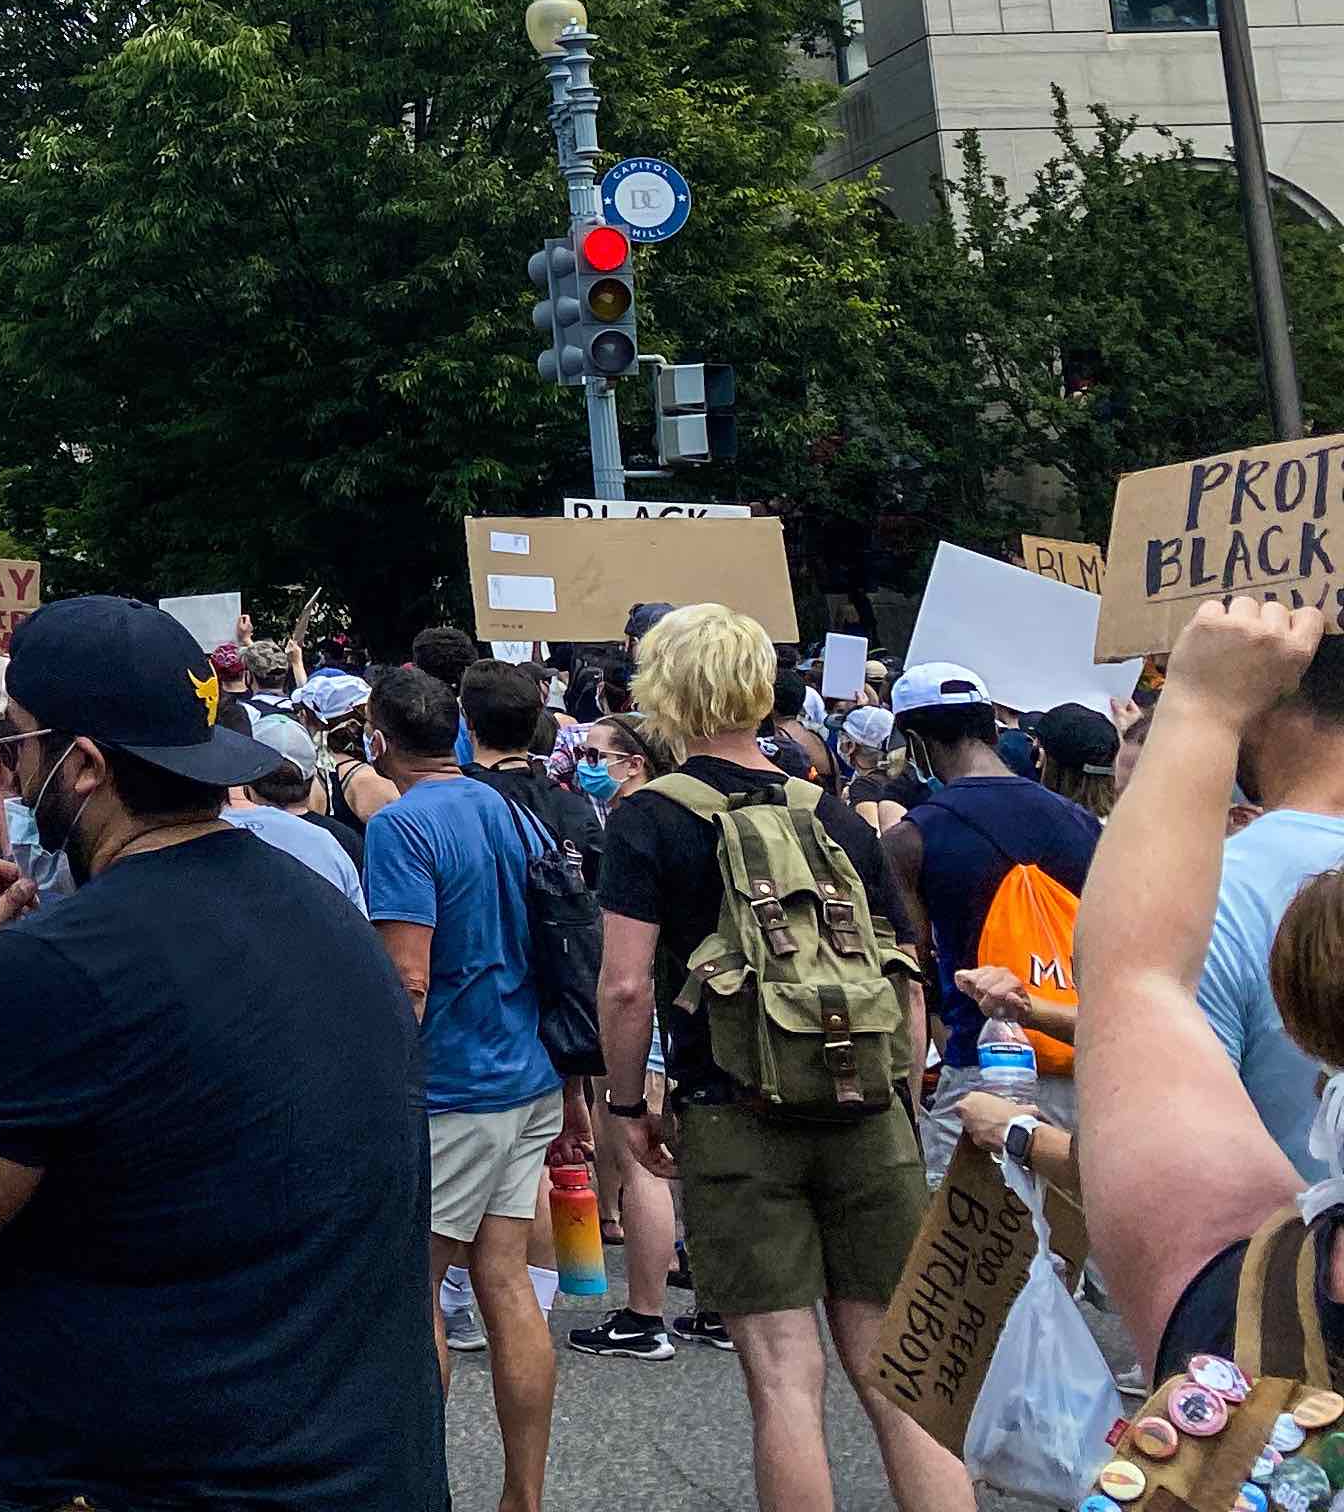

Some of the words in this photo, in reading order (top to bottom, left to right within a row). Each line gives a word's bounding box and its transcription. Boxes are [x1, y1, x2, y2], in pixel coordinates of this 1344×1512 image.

[613, 161, 669, 180] CAPITOL
[631, 188, 661, 209] DC
[632, 228, 665, 237] HILL
[1185, 445, 1344, 532] PROT
[1036, 547, 1102, 595] BLM
[1146, 522, 1335, 597] BLACK
[1029, 953, 1075, 990] M
